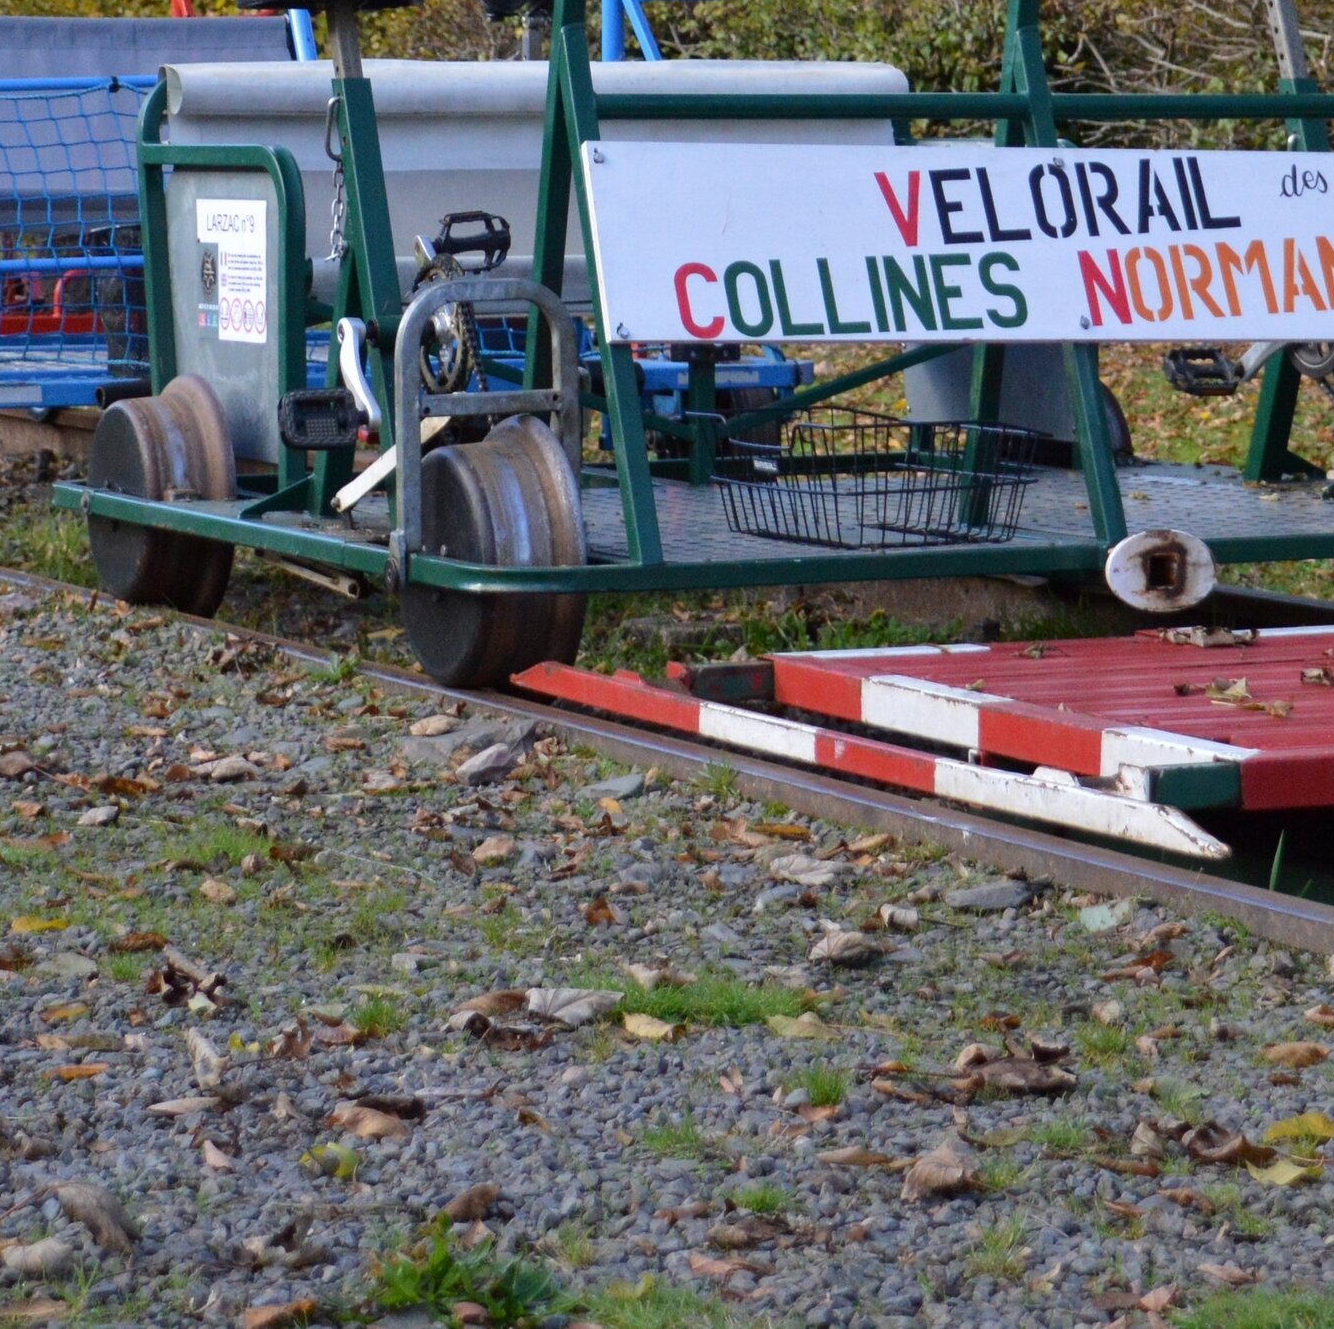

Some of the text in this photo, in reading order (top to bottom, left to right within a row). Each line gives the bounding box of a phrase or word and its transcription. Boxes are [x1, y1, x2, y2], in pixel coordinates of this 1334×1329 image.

[206, 213, 240, 233] LARZAC
[873, 155, 1329, 248] VELORAIL des
[673, 251, 1029, 339] COLLINES
